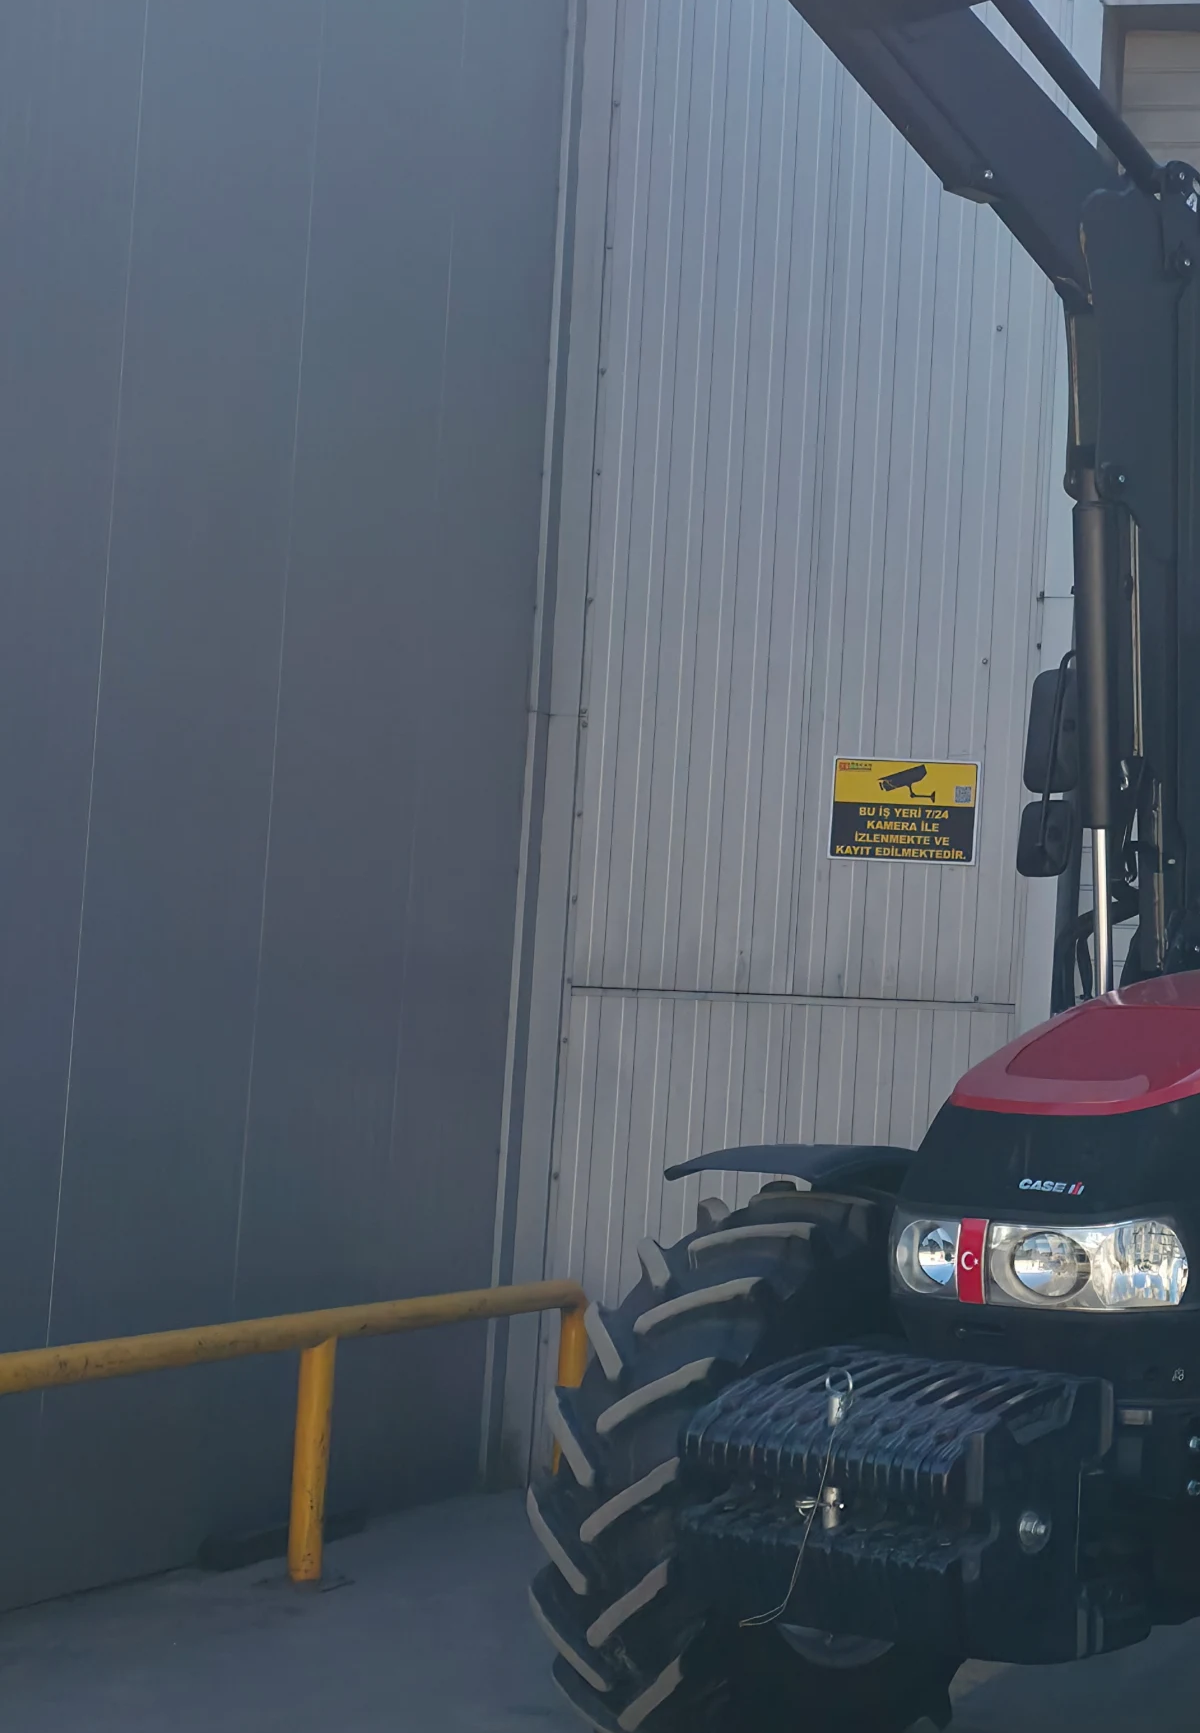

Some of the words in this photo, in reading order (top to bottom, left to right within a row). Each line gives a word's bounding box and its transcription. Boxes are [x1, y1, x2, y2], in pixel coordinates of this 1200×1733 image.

[859, 806, 875, 817] BU
[879, 805, 891, 819] İŞ
[895, 807, 922, 818] YERİ
[925, 809, 949, 820] 7/24
[867, 820, 917, 831] KAMERA
[921, 821, 939, 833] İLE
[855, 831, 930, 845] İZLENMEKTE
[935, 836, 950, 846] VE
[836, 845, 871, 856] KAYIT
[875, 845, 966, 860] EDİLMEKTEDİR.
[1018, 1178, 1067, 1193] CASE
